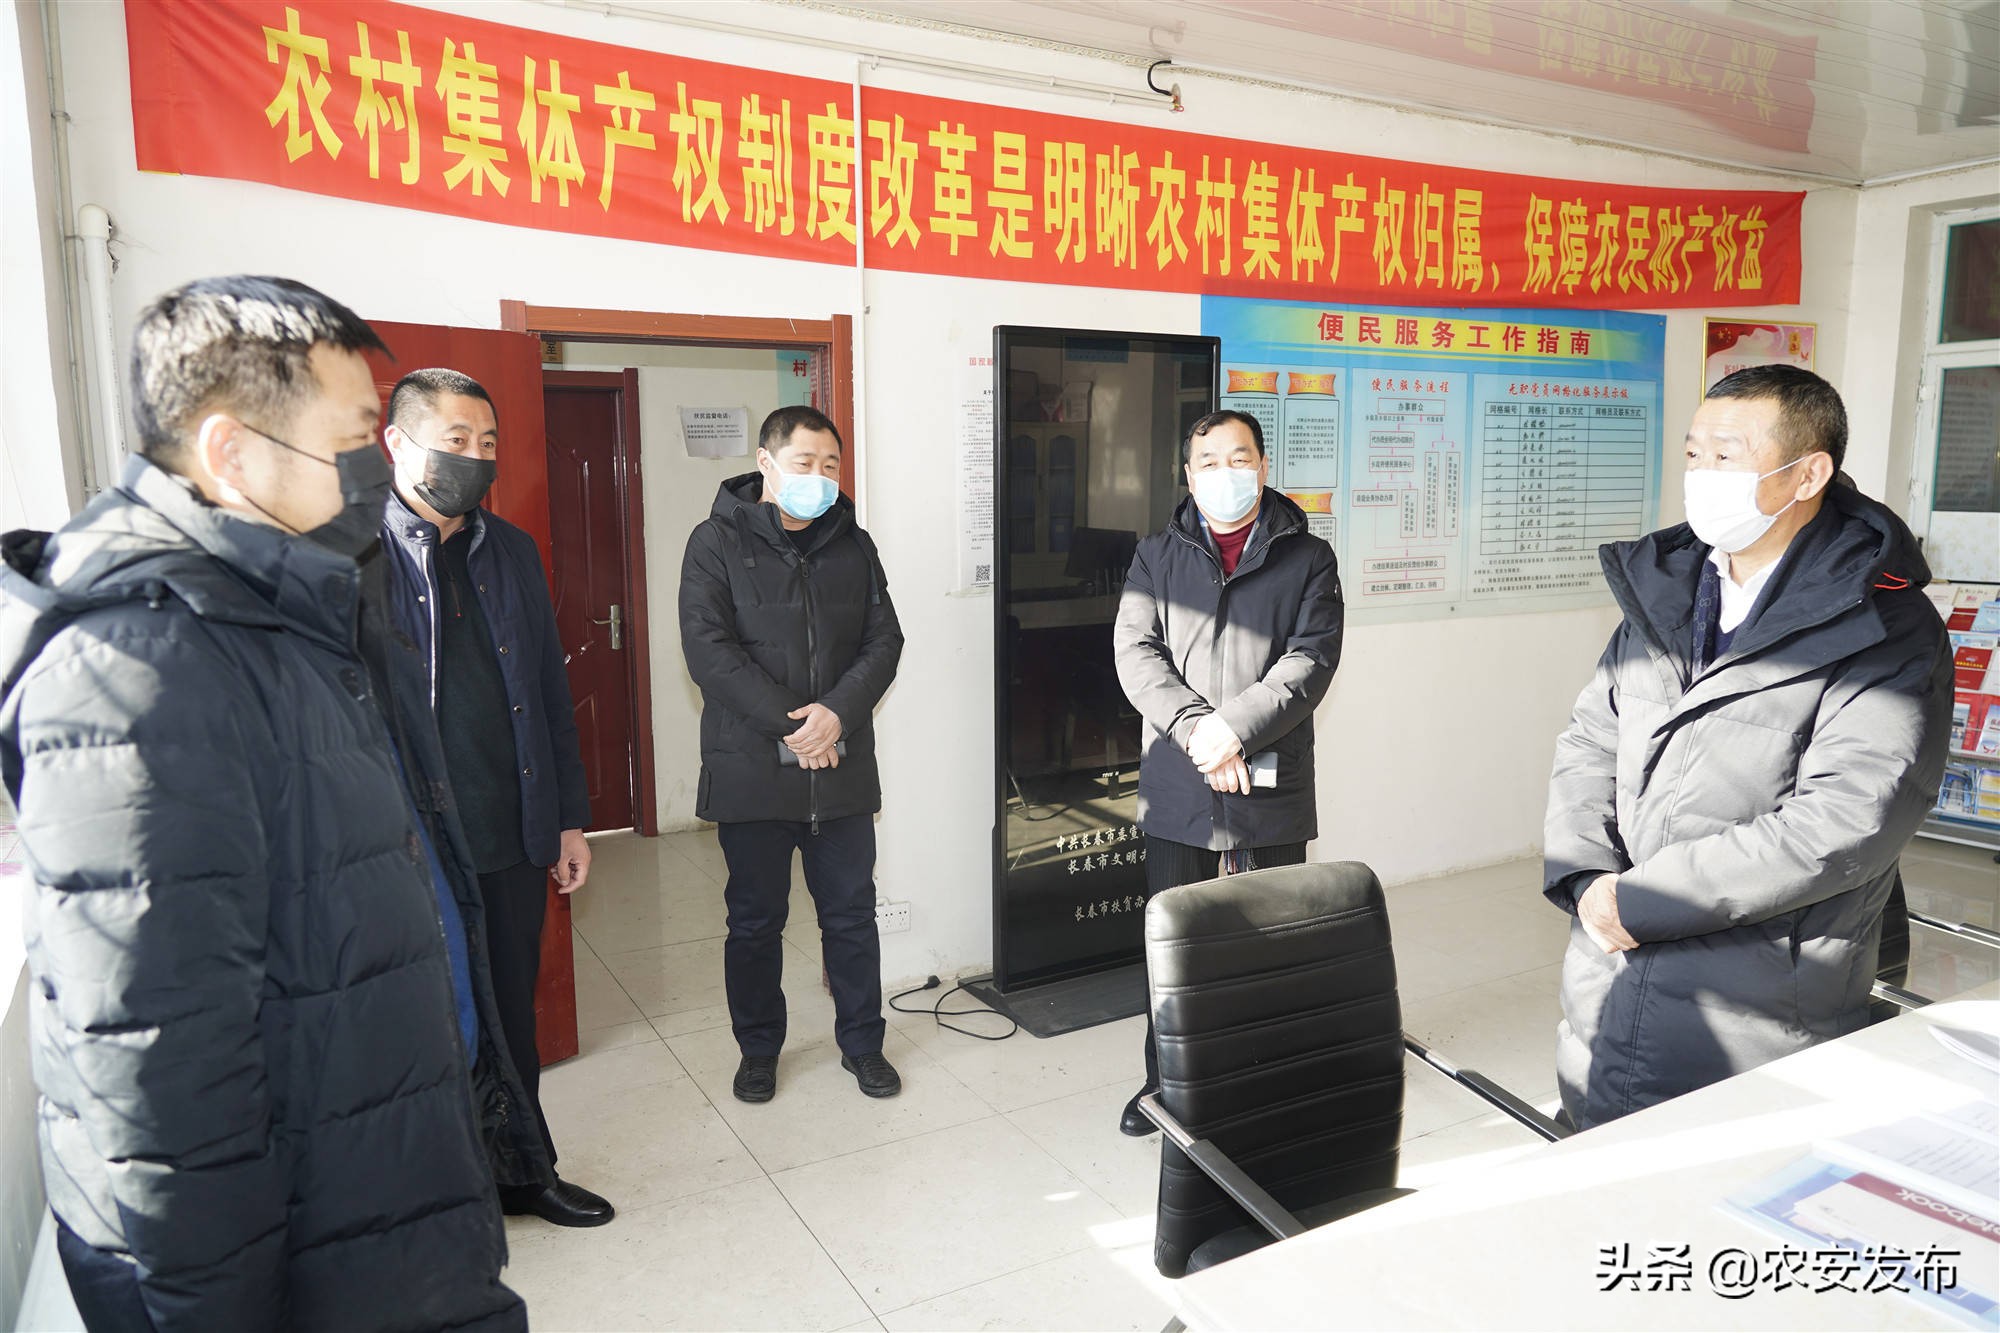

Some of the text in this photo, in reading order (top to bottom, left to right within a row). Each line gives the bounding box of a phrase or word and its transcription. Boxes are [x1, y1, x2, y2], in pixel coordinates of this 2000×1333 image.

[261, 7, 1769, 295] 农村集体产权制度改革是明晰农村集体产权归属、保障农民财产权益
[1317, 312, 1592, 356] 便民服务工作指南
[792, 359, 808, 377] 村
[1371, 378, 1450, 393] 便民服务流程
[1398, 402, 1424, 412] 办事群众
[1490, 405, 1518, 415] 网格编号
[1528, 406, 1548, 415] 网格长
[1558, 407, 1584, 416] 联系方式
[1056, 824, 1145, 854] 中共长春市委宣
[1075, 895, 1145, 922] 长春市扶贫办
